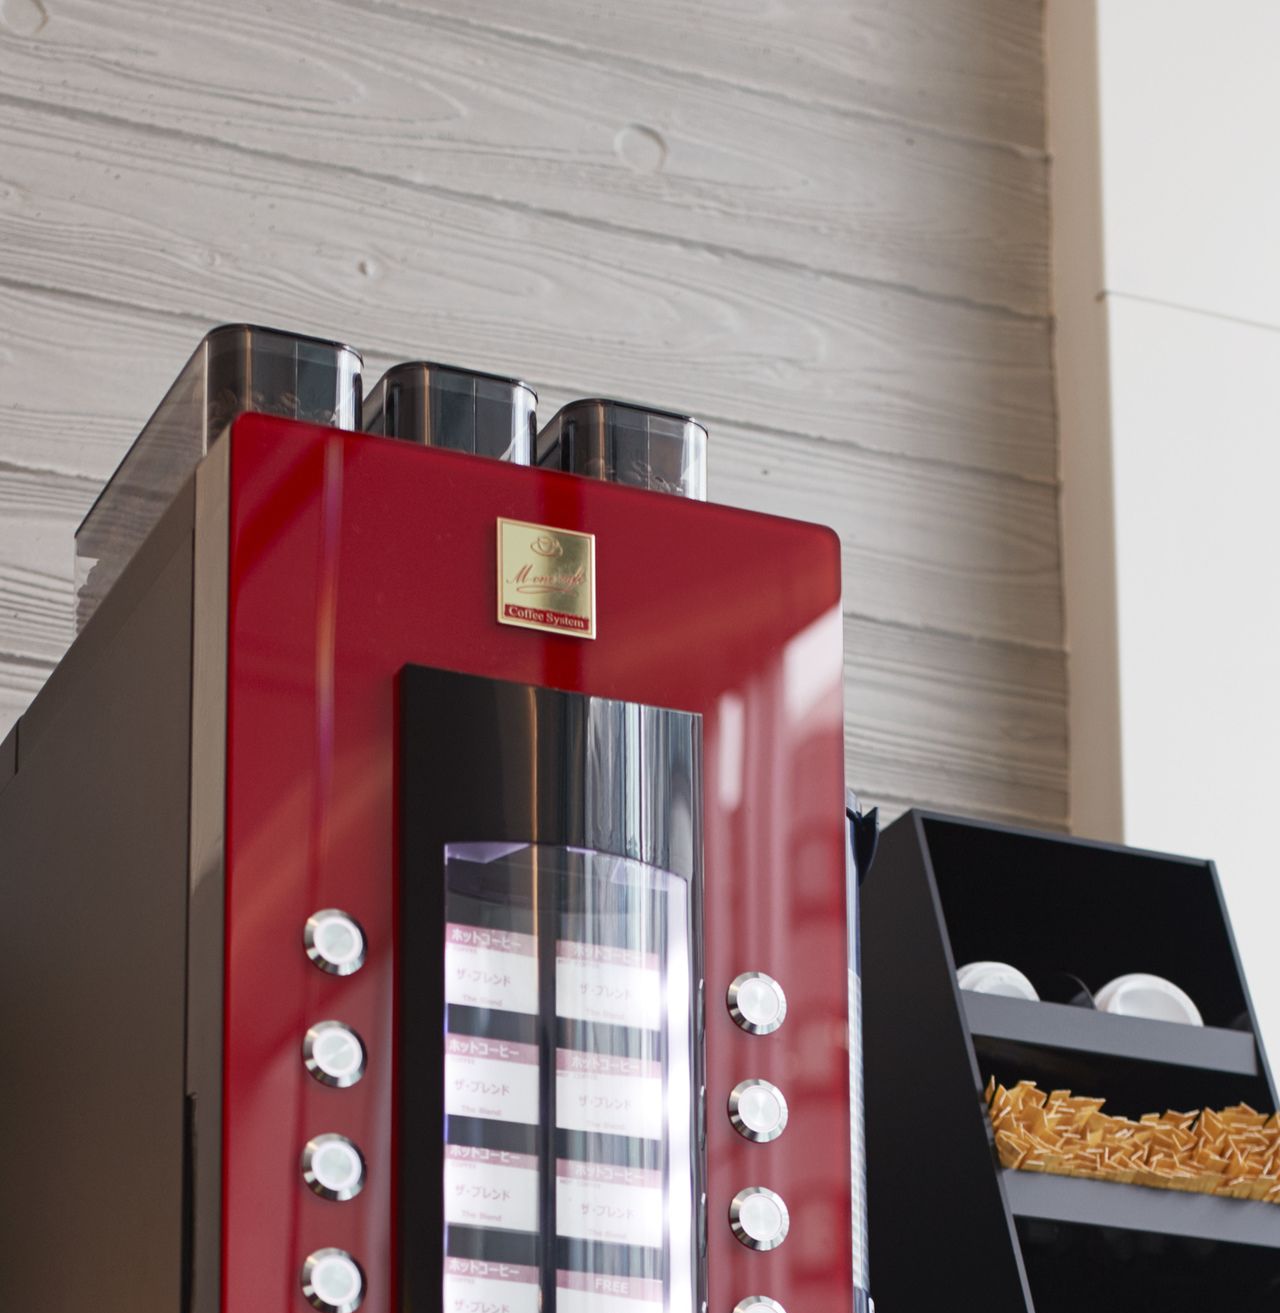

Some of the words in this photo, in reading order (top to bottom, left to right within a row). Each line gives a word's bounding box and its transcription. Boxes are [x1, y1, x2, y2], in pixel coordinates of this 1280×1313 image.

[508, 606, 544, 622] Coffee
[545, 612, 585, 629] System
[451, 928, 522, 949] ホットコーヒー
[449, 1040, 520, 1059] ホットコーヒー
[449, 1145, 522, 1164] ホットコーヒー
[449, 1259, 520, 1277] ホットコーヒー
[595, 1277, 629, 1295] FREE
